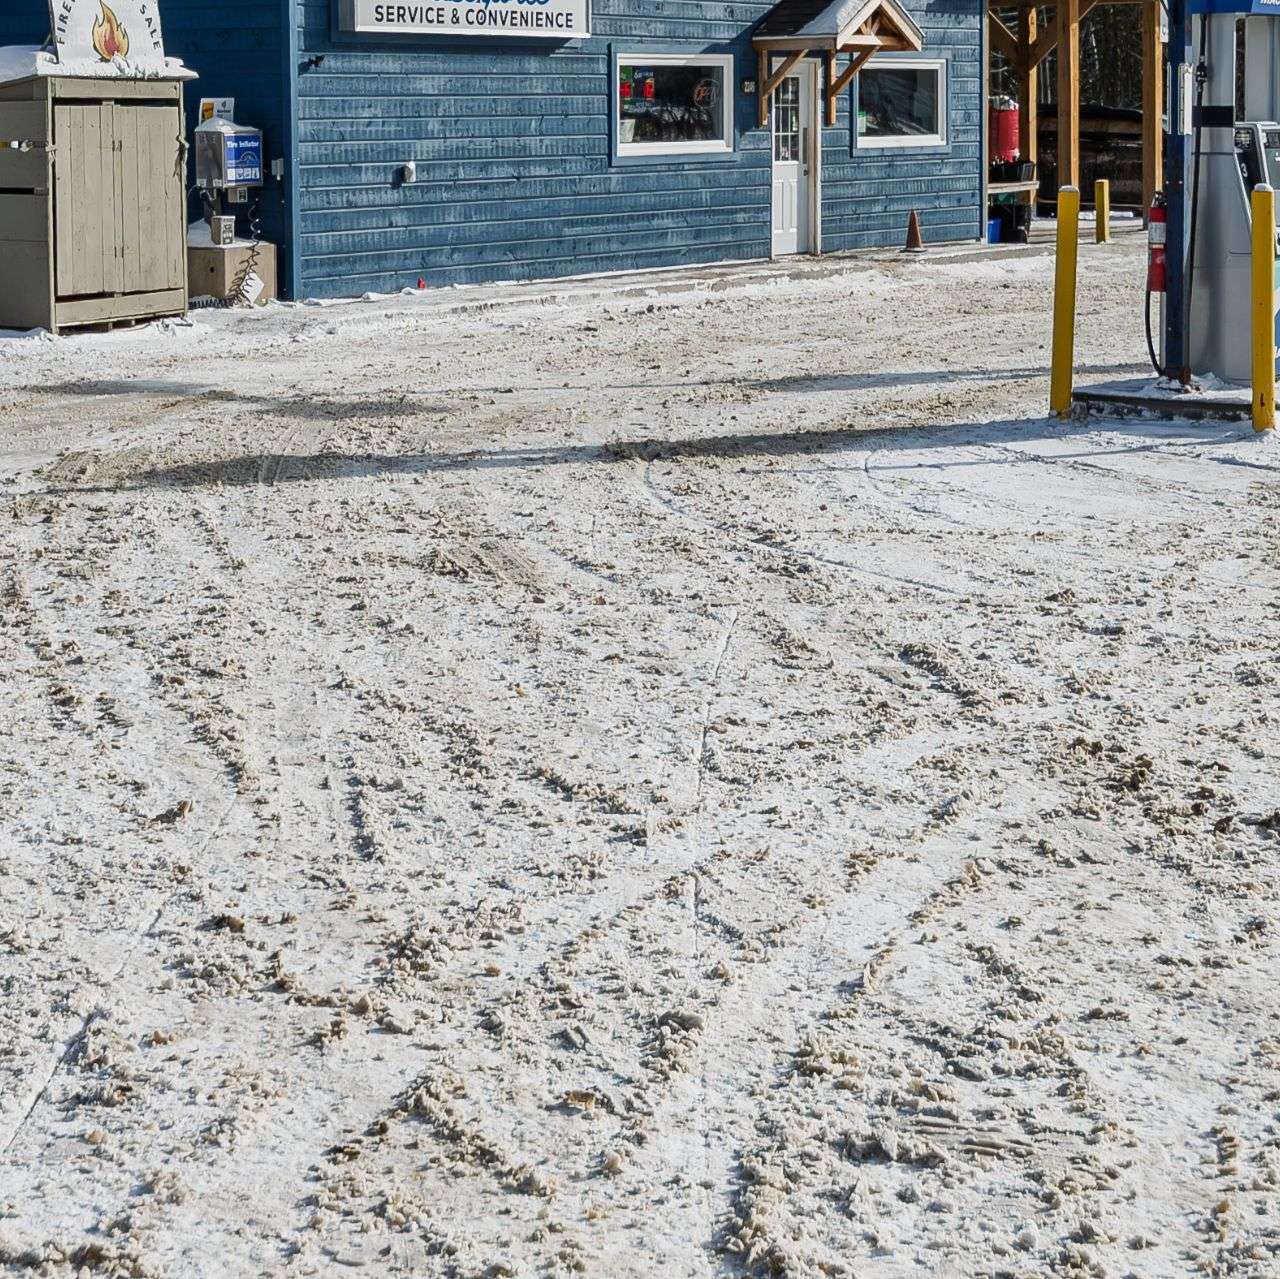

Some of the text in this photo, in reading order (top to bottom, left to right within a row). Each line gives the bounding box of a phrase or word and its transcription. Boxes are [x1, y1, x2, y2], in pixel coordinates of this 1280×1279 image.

[139, 3, 162, 51] SALE
[374, 5, 574, 29] SERVICE & CONVENIENCE
